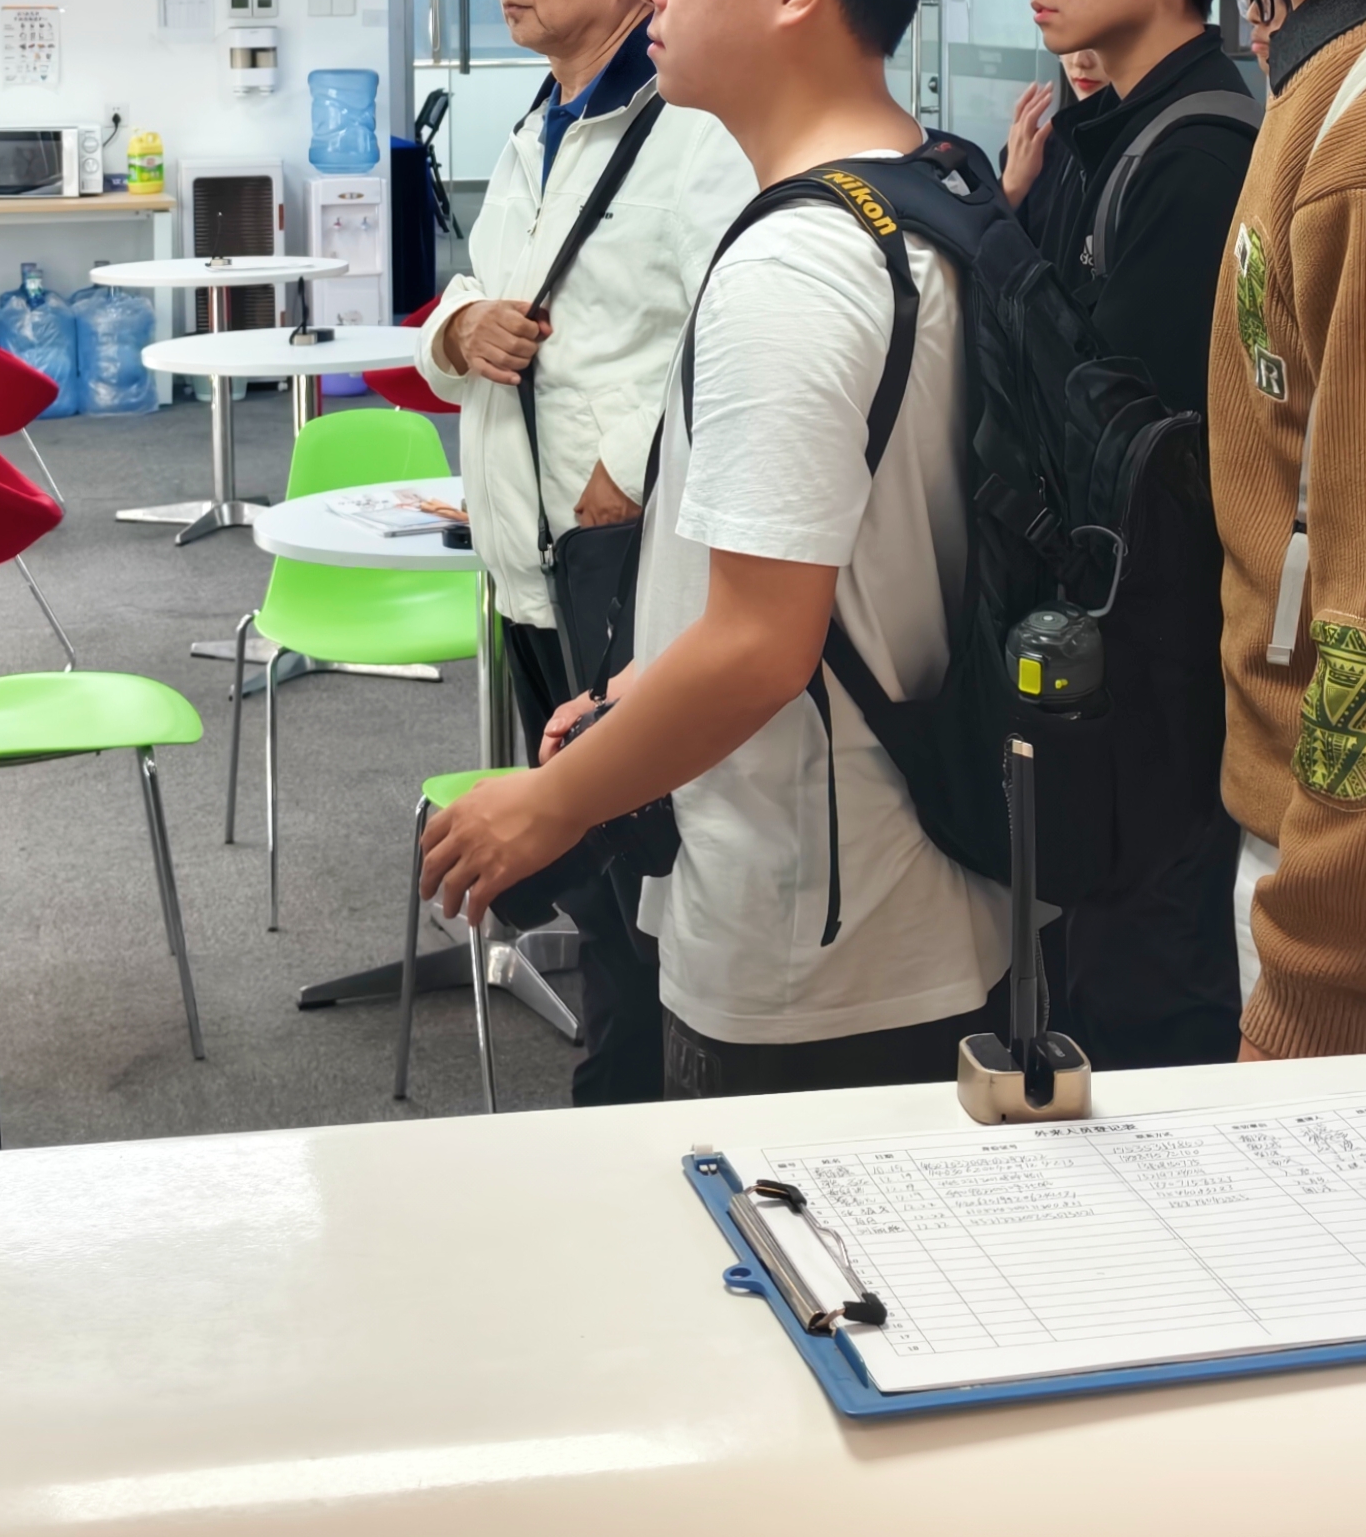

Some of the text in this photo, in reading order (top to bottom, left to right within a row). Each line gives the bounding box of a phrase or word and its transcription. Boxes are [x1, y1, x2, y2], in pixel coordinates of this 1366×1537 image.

[822, 172, 897, 236] Nikon
[1034, 1123, 1138, 1138] 外来人员登记表
